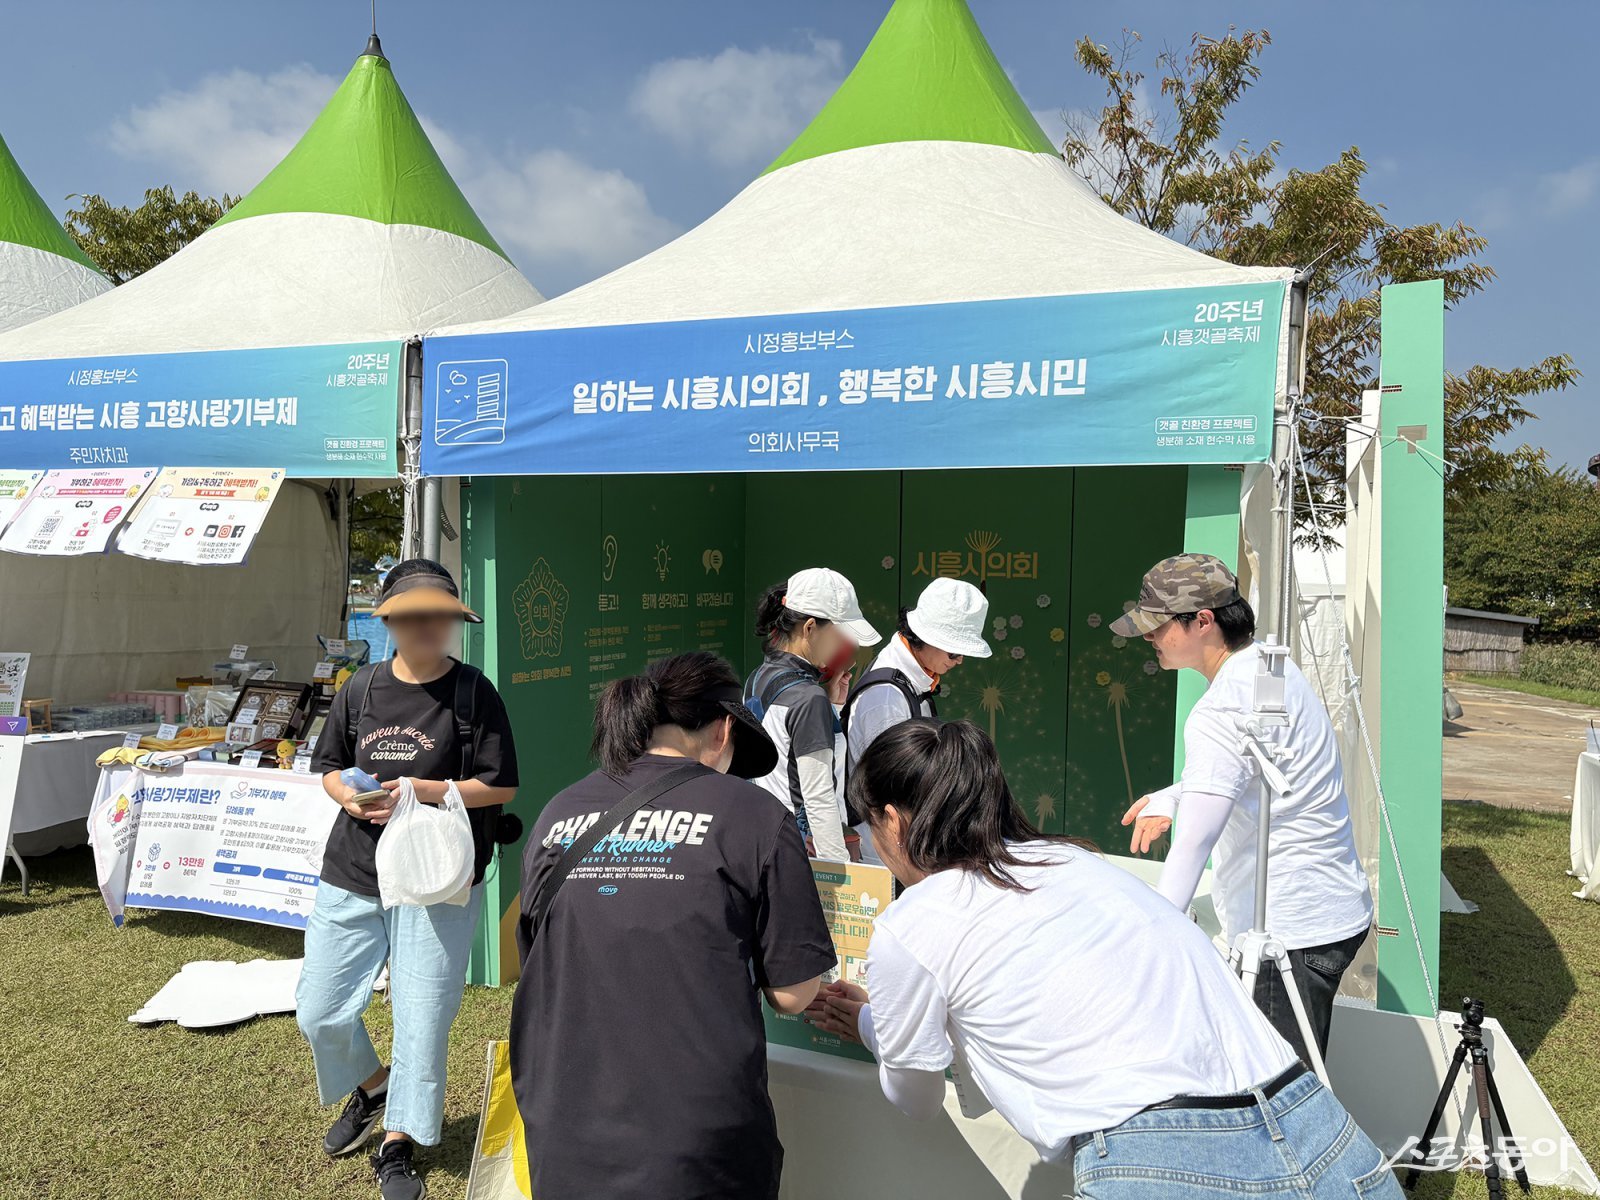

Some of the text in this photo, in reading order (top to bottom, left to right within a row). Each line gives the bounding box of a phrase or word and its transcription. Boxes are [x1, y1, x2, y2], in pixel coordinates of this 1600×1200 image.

[1194, 299, 1264, 323] 20주년
[744, 329, 855, 354] 시정홍보부스
[1161, 326, 1260, 346] 시흥갯골축제
[347, 353, 390, 370] 20주년
[68, 368, 138, 386] 시정홍보부스
[326, 373, 388, 387] 시흥갯골축제
[573, 380, 654, 414] 일하는
[661, 371, 810, 410] 시흥시의회
[839, 365, 938, 405] 행복한
[945, 358, 1087, 399] 시흥시민
[20, 403, 95, 431] 혜택받는
[100, 401, 140, 430] 시흥
[145, 397, 298, 429] 고향사랑기부제
[1159, 418, 1253, 431] 갯골 친환경 프로젝트
[747, 431, 839, 453] 의회사무국
[1186, 435, 1204, 446] 소재
[1206, 435, 1234, 446] 현수막
[1236, 434, 1256, 445] 사용
[69, 446, 128, 464] 주민자치과
[223, 479, 259, 488] 혜택받자!
[912, 551, 1038, 581] 시흥시의회
[642, 592, 688, 610] 함께 생각하고!
[533, 604, 551, 621] 의회
[361, 726, 435, 751] saveur sucré
[377, 740, 414, 751] Crème
[371, 750, 418, 761] caramel
[247, 788, 287, 801] 기부자 혜택
[542, 809, 714, 849] CHALENGE
[607, 833, 676, 857] Runner
[178, 856, 205, 868] 13만원
[632, 856, 672, 864] CHANGE
[815, 872, 833, 880] EVENT
[837, 902, 878, 917] 팔로우하면!
